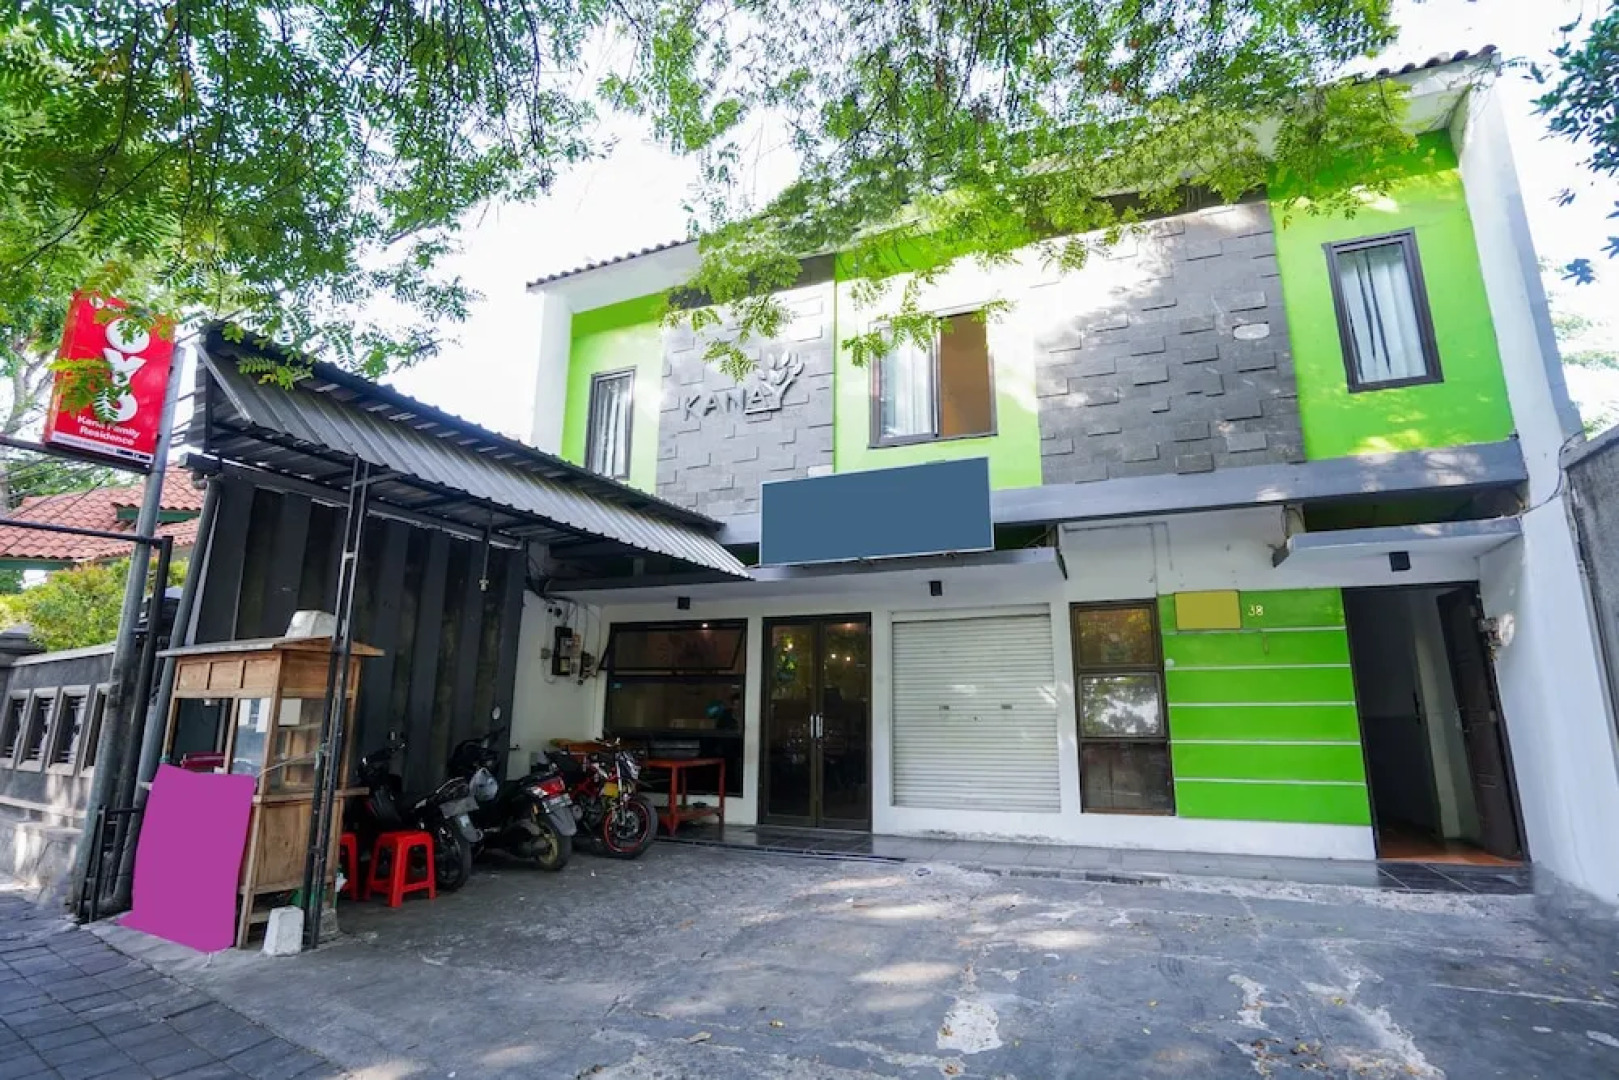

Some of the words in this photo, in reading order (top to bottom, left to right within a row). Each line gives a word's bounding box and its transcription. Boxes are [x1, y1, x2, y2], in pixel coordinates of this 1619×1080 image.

[93, 317, 150, 422] OYO
[79, 425, 135, 446] Residence
[1247, 604, 1264, 616] 38
